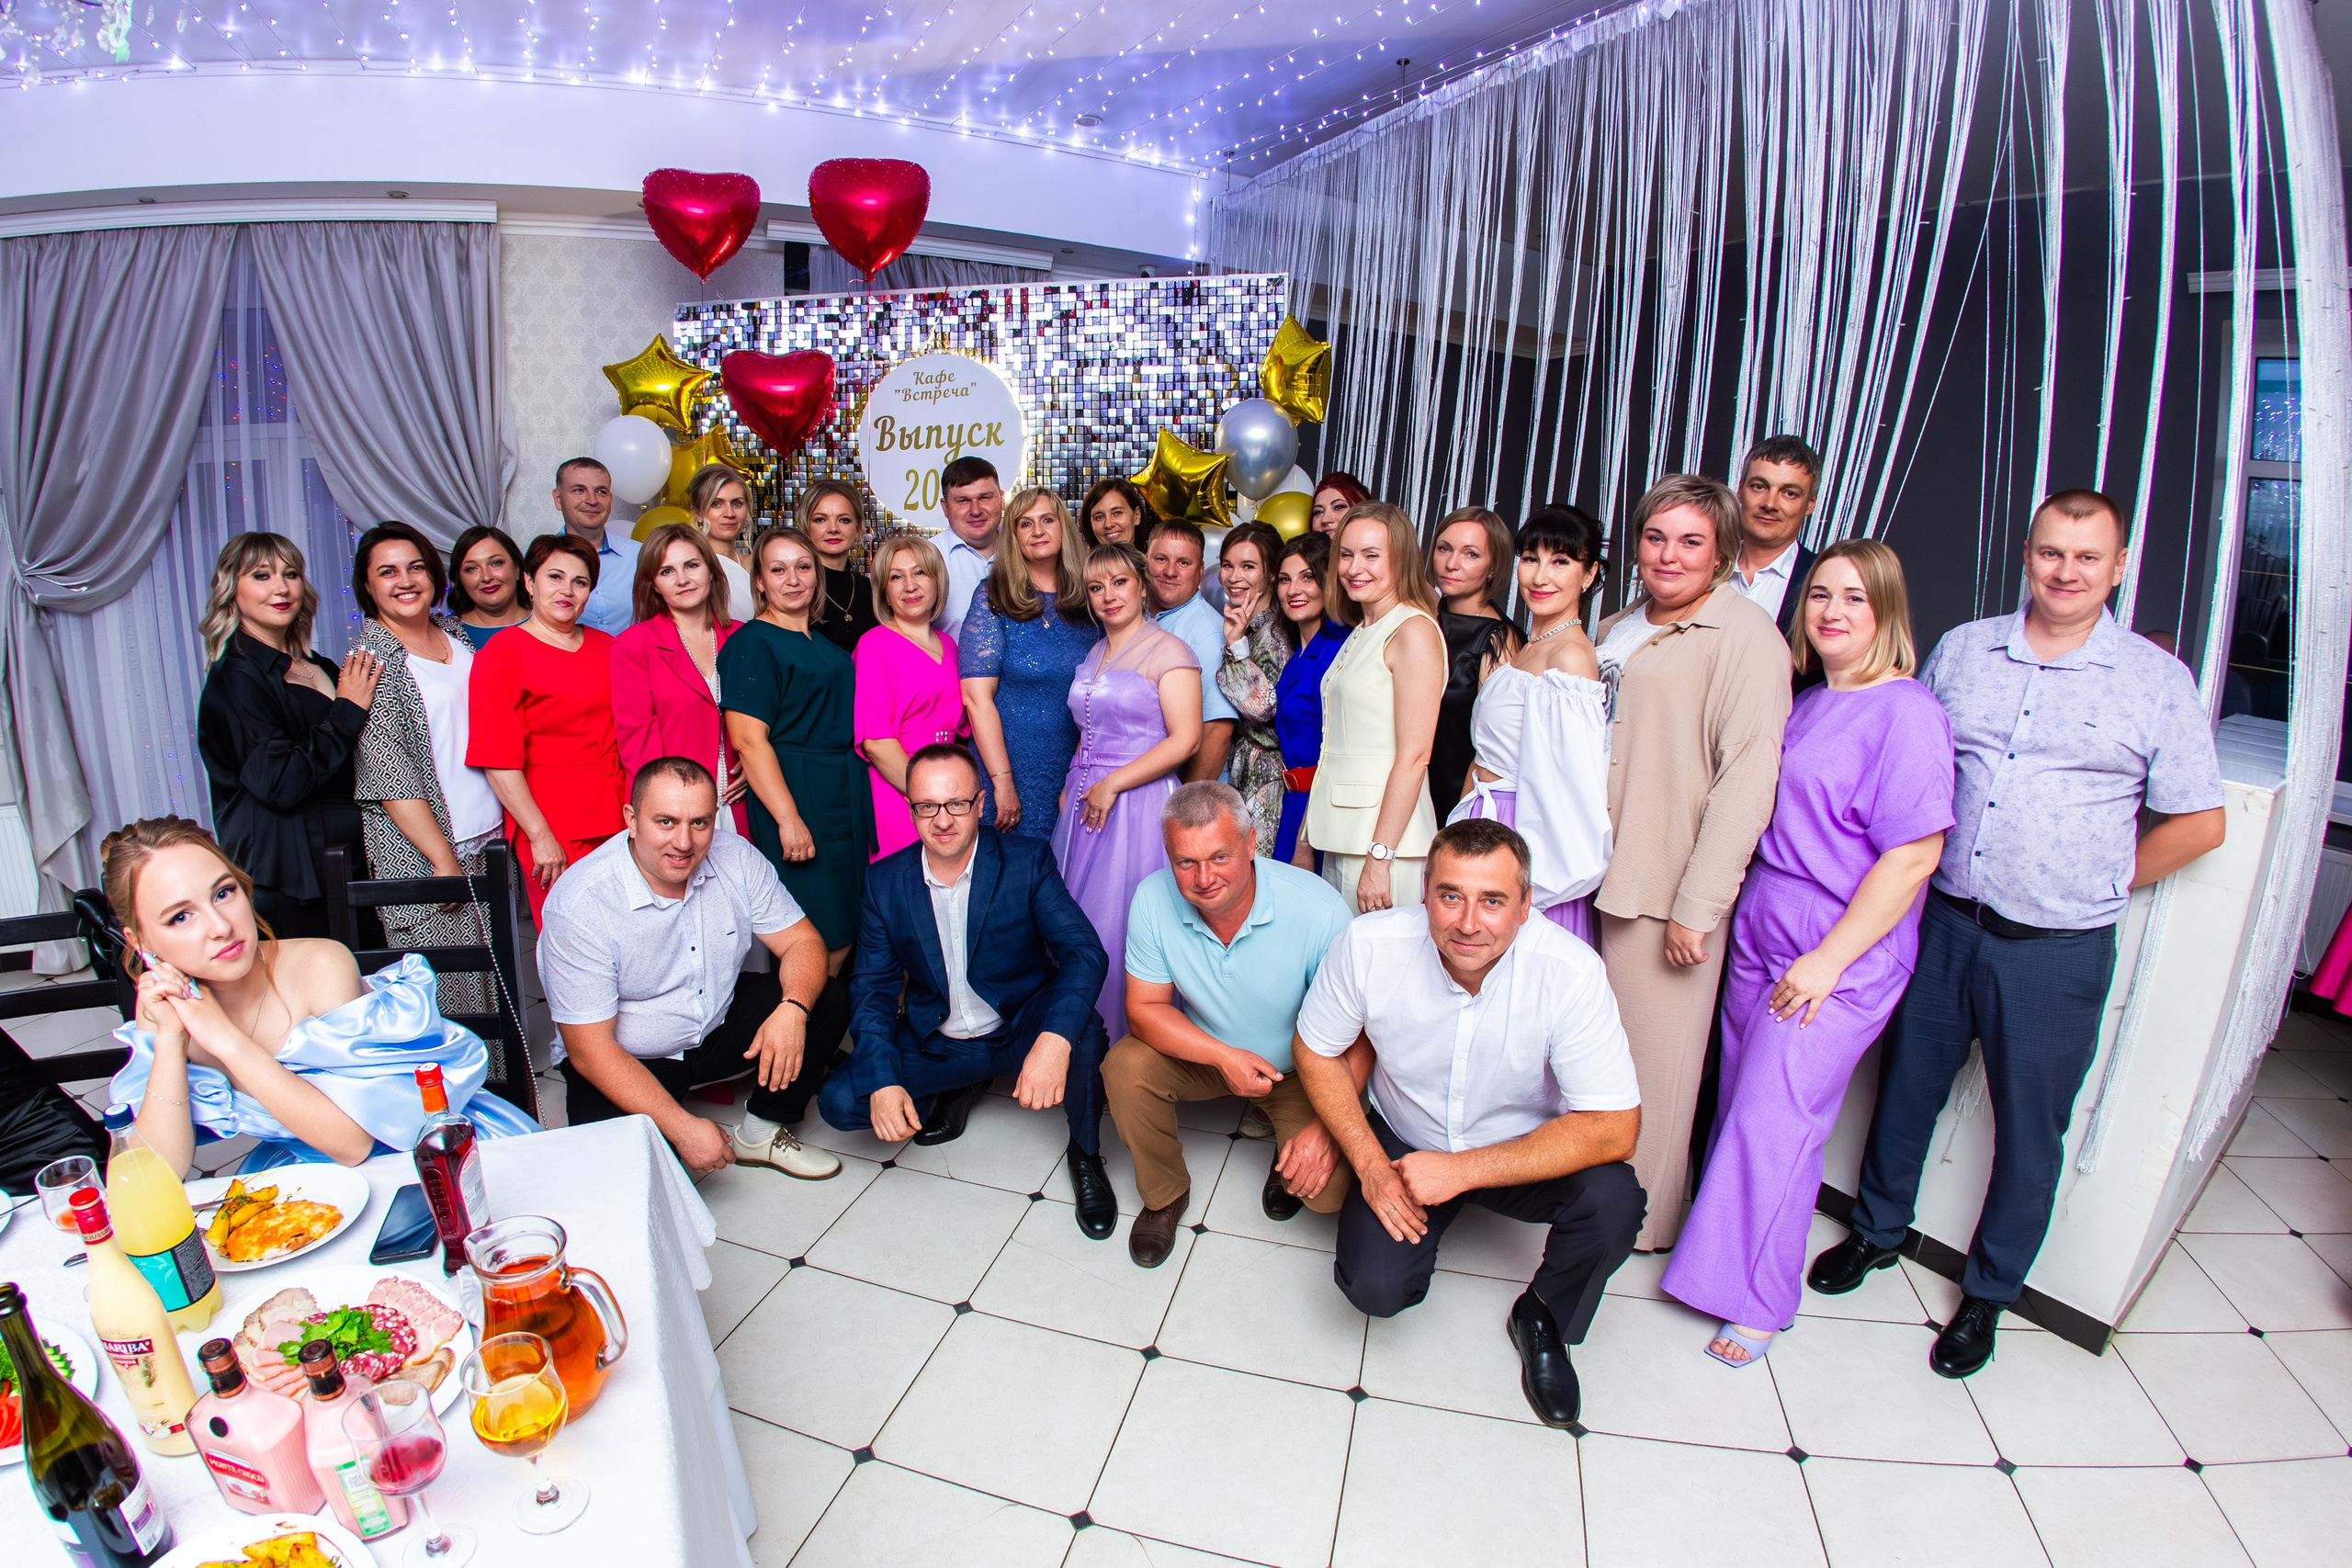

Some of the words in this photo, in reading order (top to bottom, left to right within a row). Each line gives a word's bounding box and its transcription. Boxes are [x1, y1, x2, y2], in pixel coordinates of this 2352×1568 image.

[912, 369, 956, 389] Кафе
[874, 415, 1004, 466] Выпуск
[904, 468, 940, 511] 20
[209, 1459, 238, 1473] MONTE
